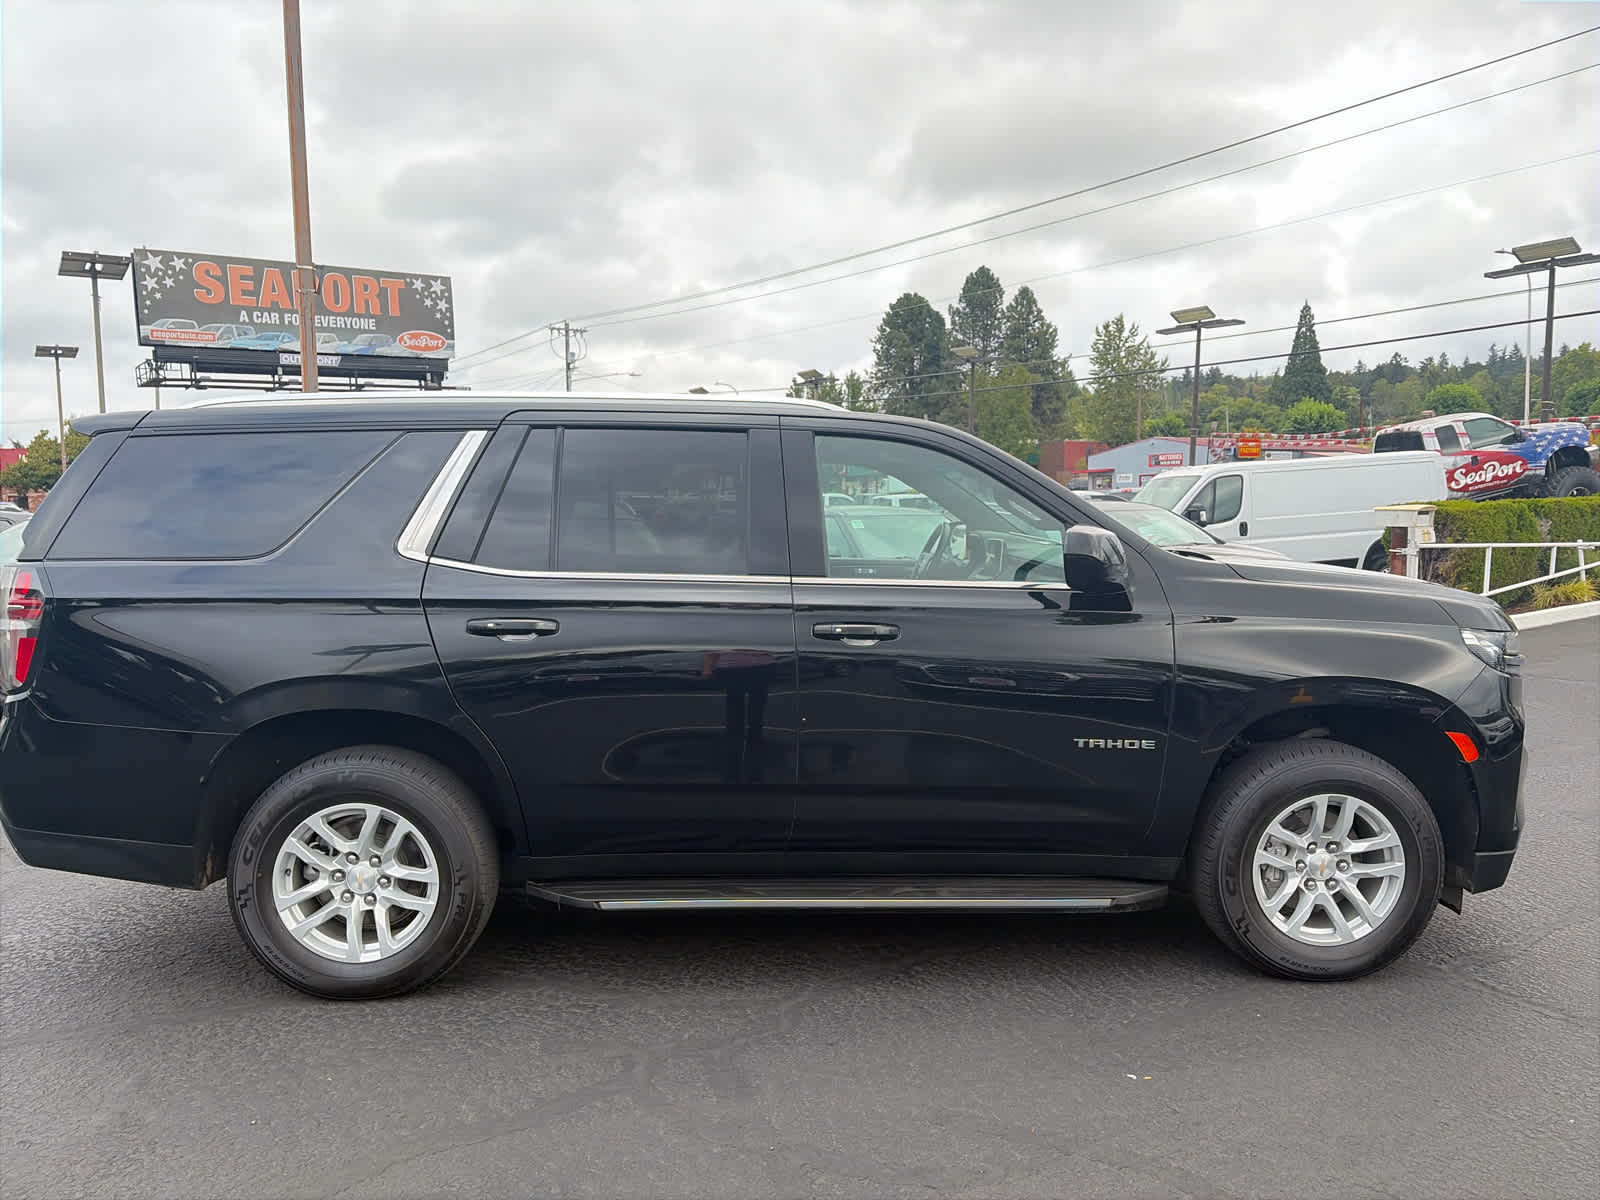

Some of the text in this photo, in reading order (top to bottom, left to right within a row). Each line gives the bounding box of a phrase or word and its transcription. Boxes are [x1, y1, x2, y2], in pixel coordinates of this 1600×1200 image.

[239, 310, 377, 330] A CAR FO EVERYONE
[400, 335, 443, 348] SeaPort
[1450, 460, 1523, 489] SeaPort
[1073, 738, 1156, 750] TAHOE
